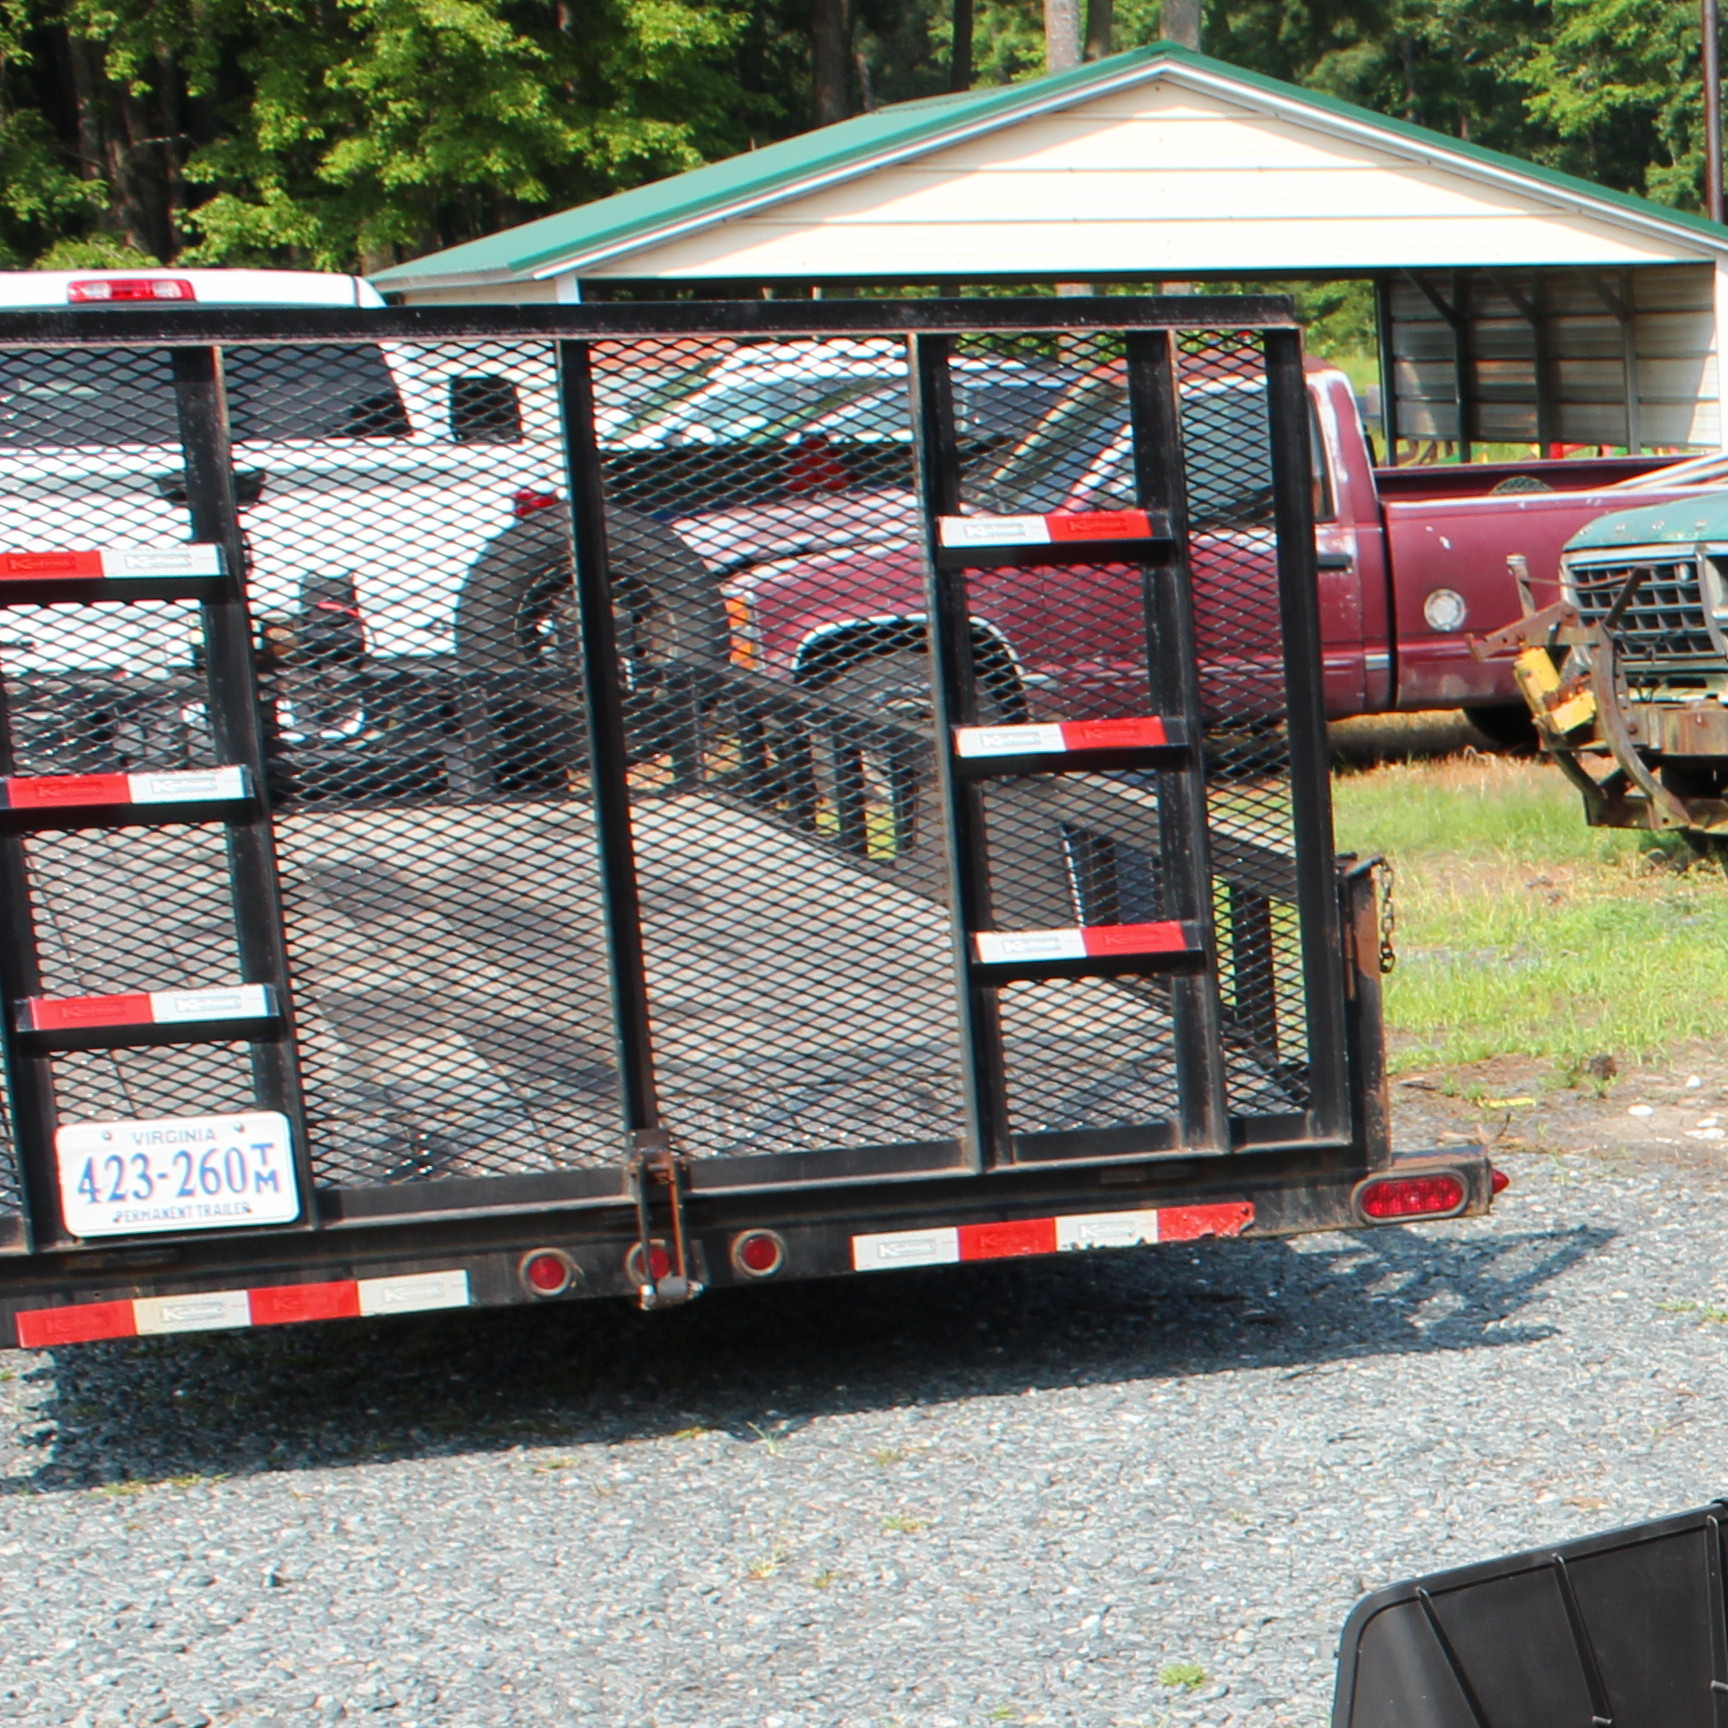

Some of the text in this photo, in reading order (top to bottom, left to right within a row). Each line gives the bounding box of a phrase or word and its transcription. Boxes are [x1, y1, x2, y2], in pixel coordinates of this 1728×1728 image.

[132, 1128, 217, 1146] VIRGINIA
[77, 1147, 249, 1204] 423-260
[115, 1201, 251, 1224] PERMANENT TRAILER
